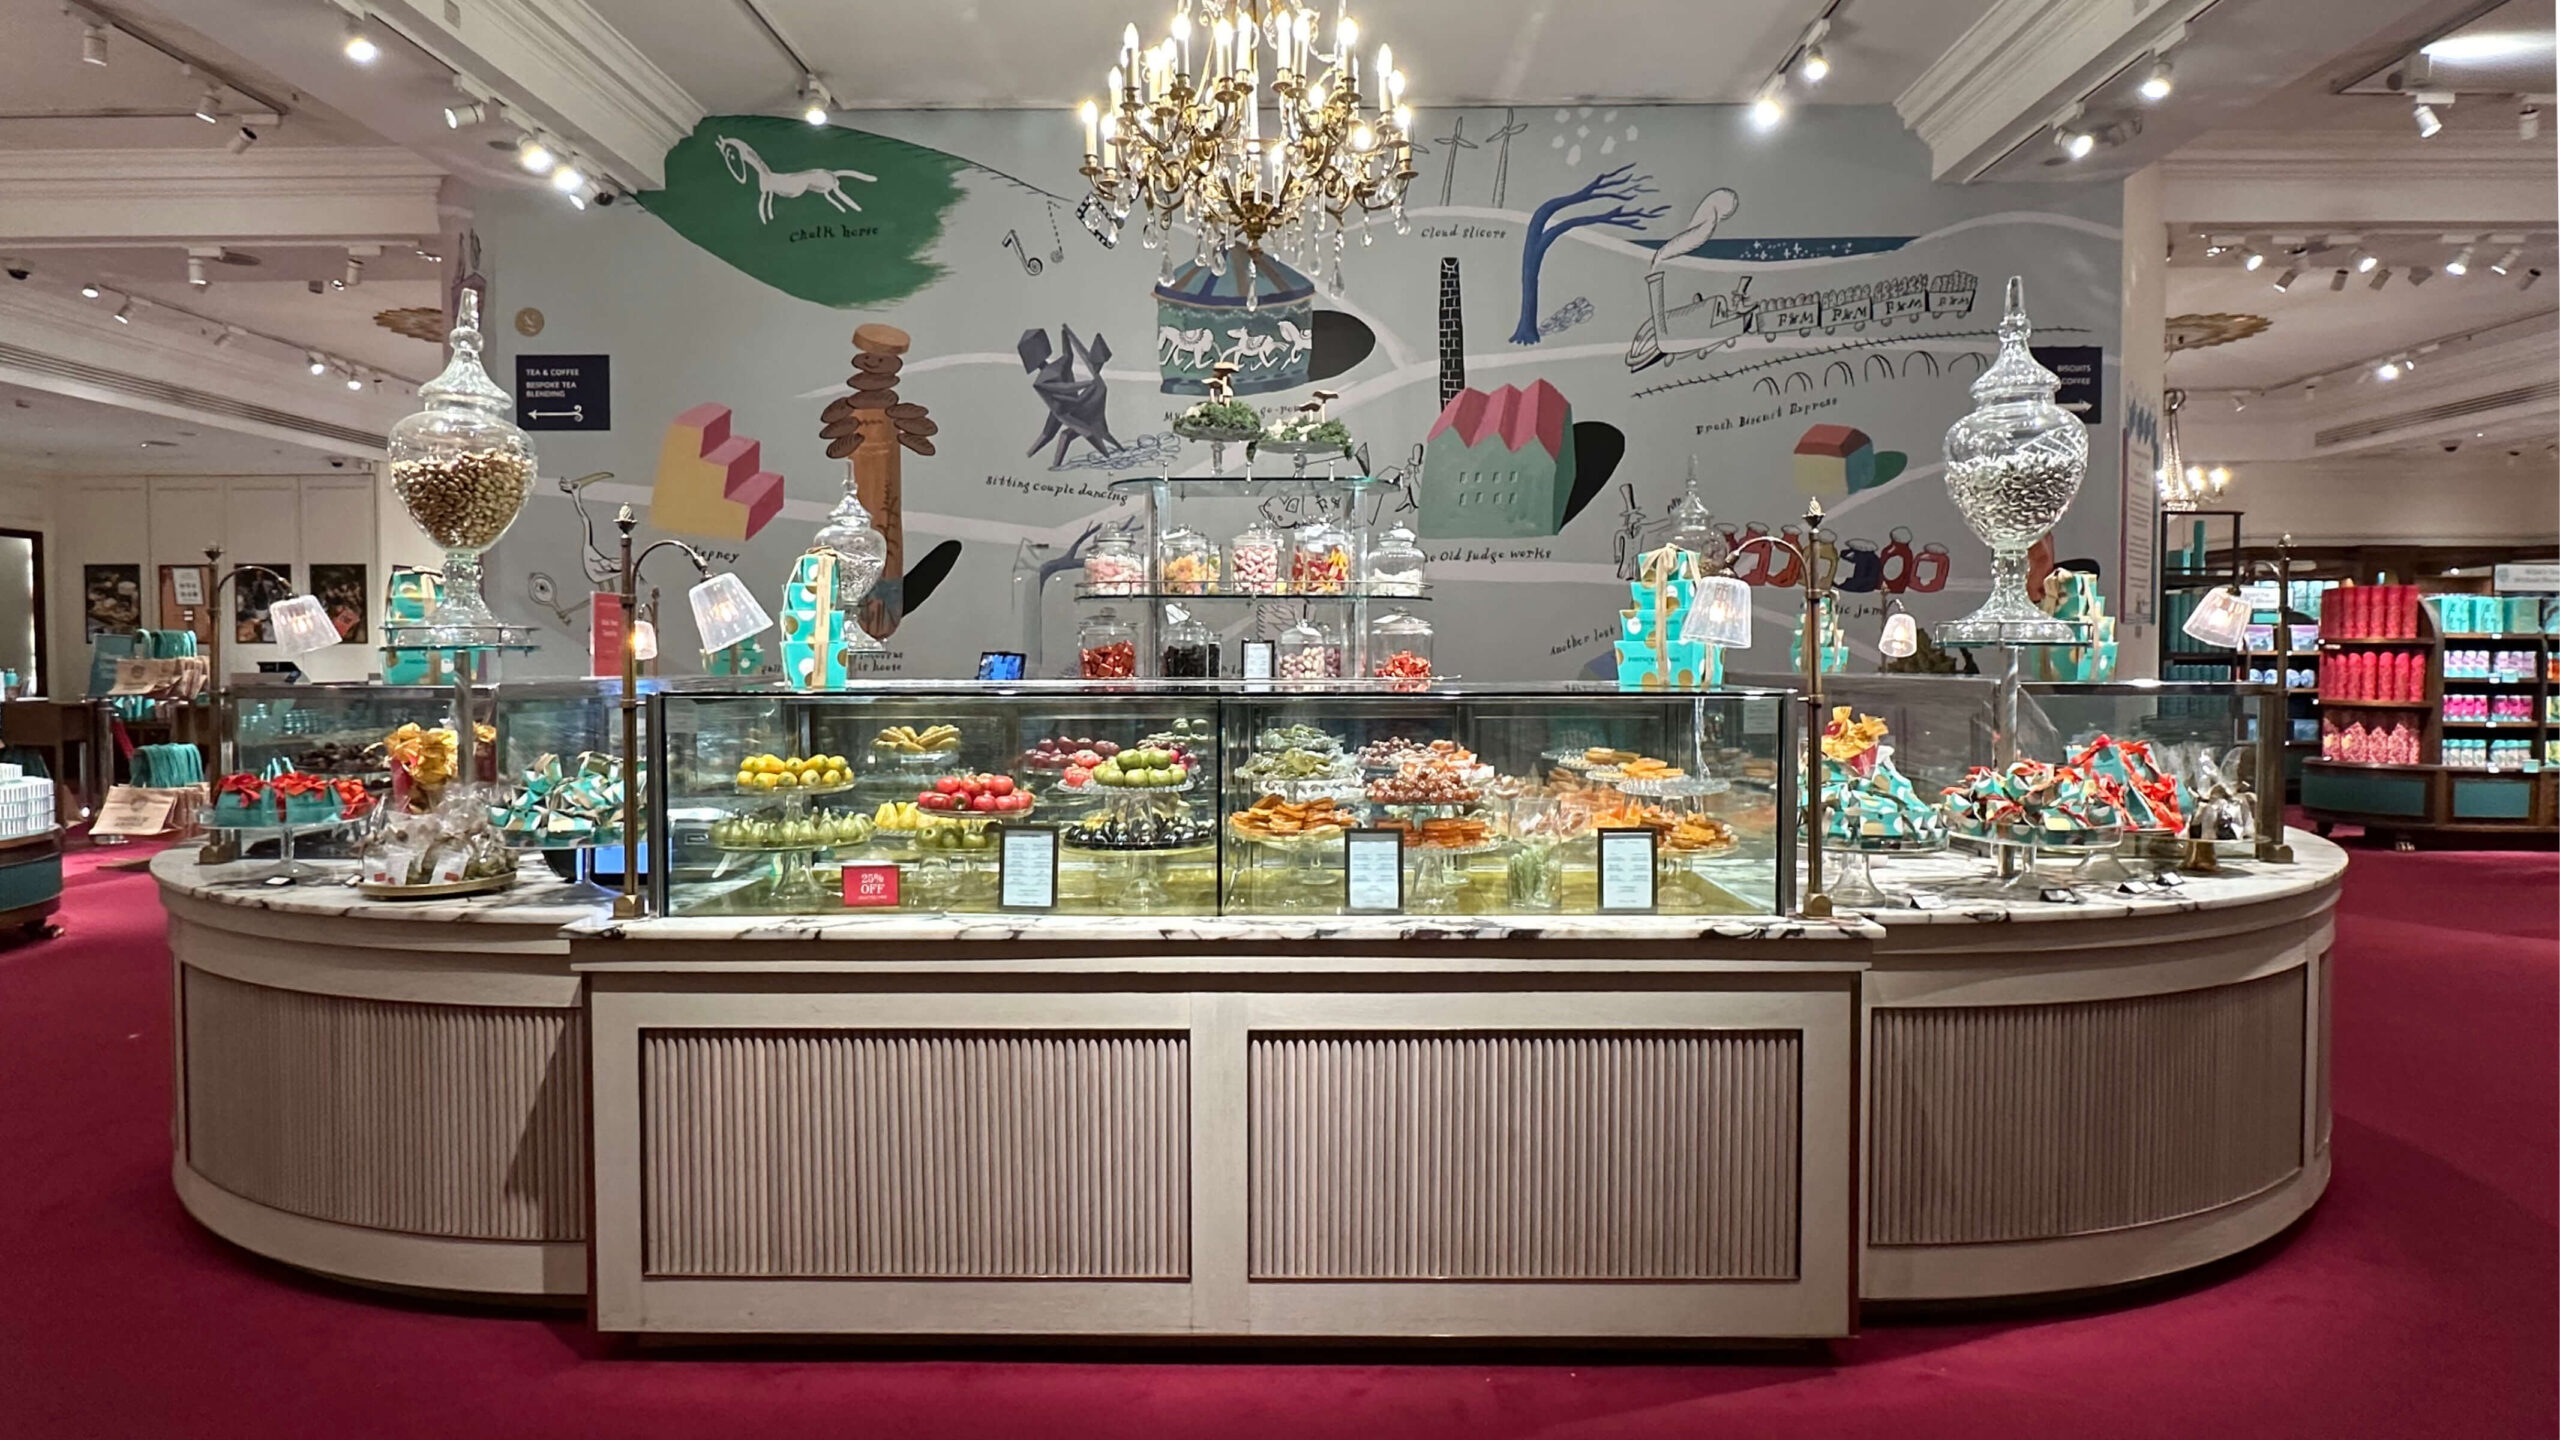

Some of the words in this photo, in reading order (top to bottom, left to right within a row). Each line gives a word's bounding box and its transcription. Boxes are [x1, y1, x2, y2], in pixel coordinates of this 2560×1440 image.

[550, 368, 580, 376] COFFEE
[526, 381, 560, 389] BESPOKE
[562, 381, 577, 389] TEA
[526, 390, 566, 398] BLENDING
[1032, 482, 1075, 497] couple
[1078, 482, 1129, 507] dancing
[1440, 547, 1461, 561] Old
[861, 873, 885, 883] 25%
[860, 883, 886, 895] OFF
